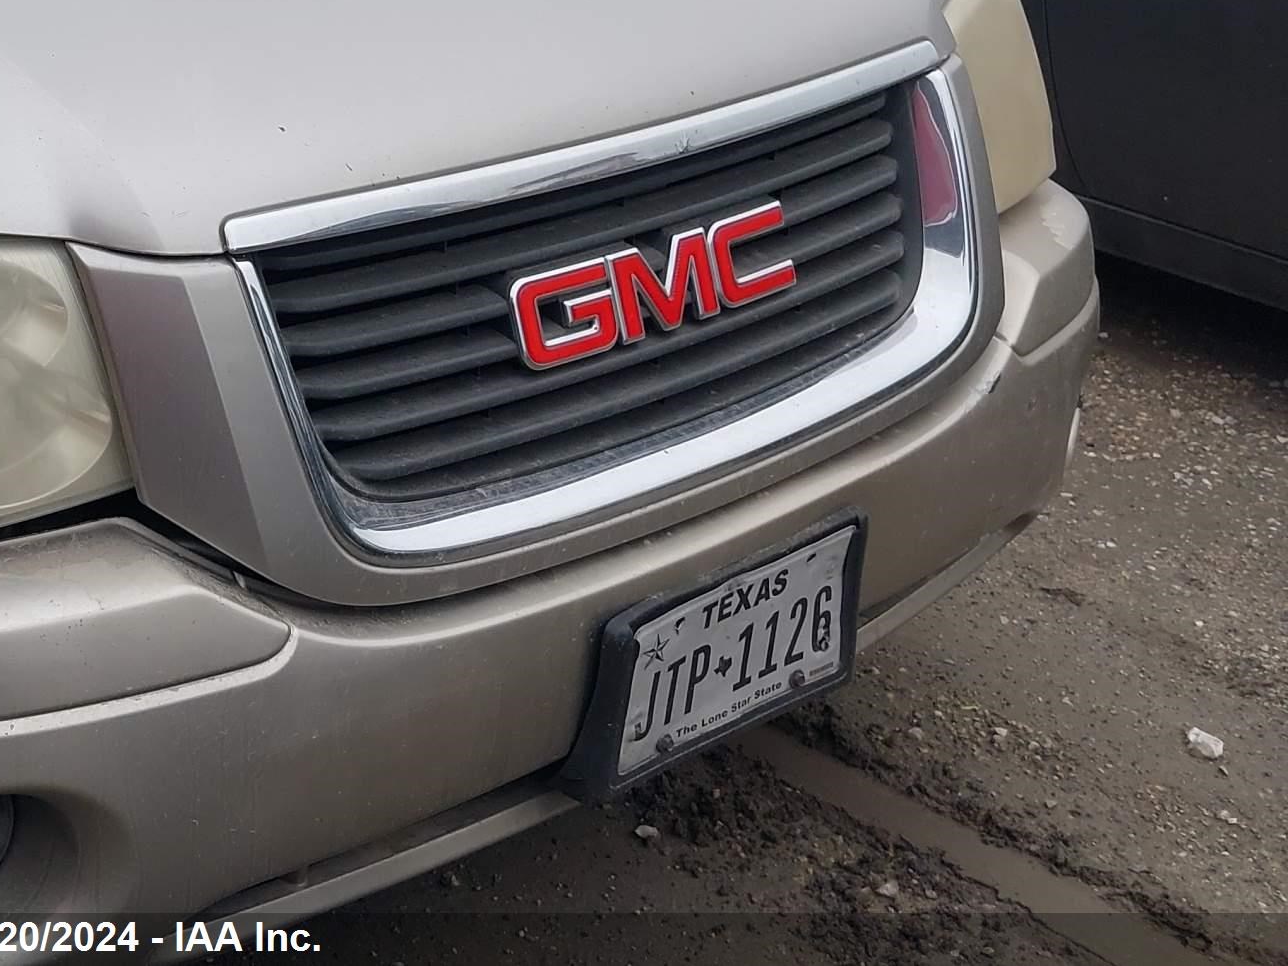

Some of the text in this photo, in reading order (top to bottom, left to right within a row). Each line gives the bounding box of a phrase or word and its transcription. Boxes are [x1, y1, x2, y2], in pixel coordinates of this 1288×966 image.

[509, 200, 797, 371] GMC
[702, 568, 789, 629] TEXAS
[675, 682, 782, 739] The Lone Star State
